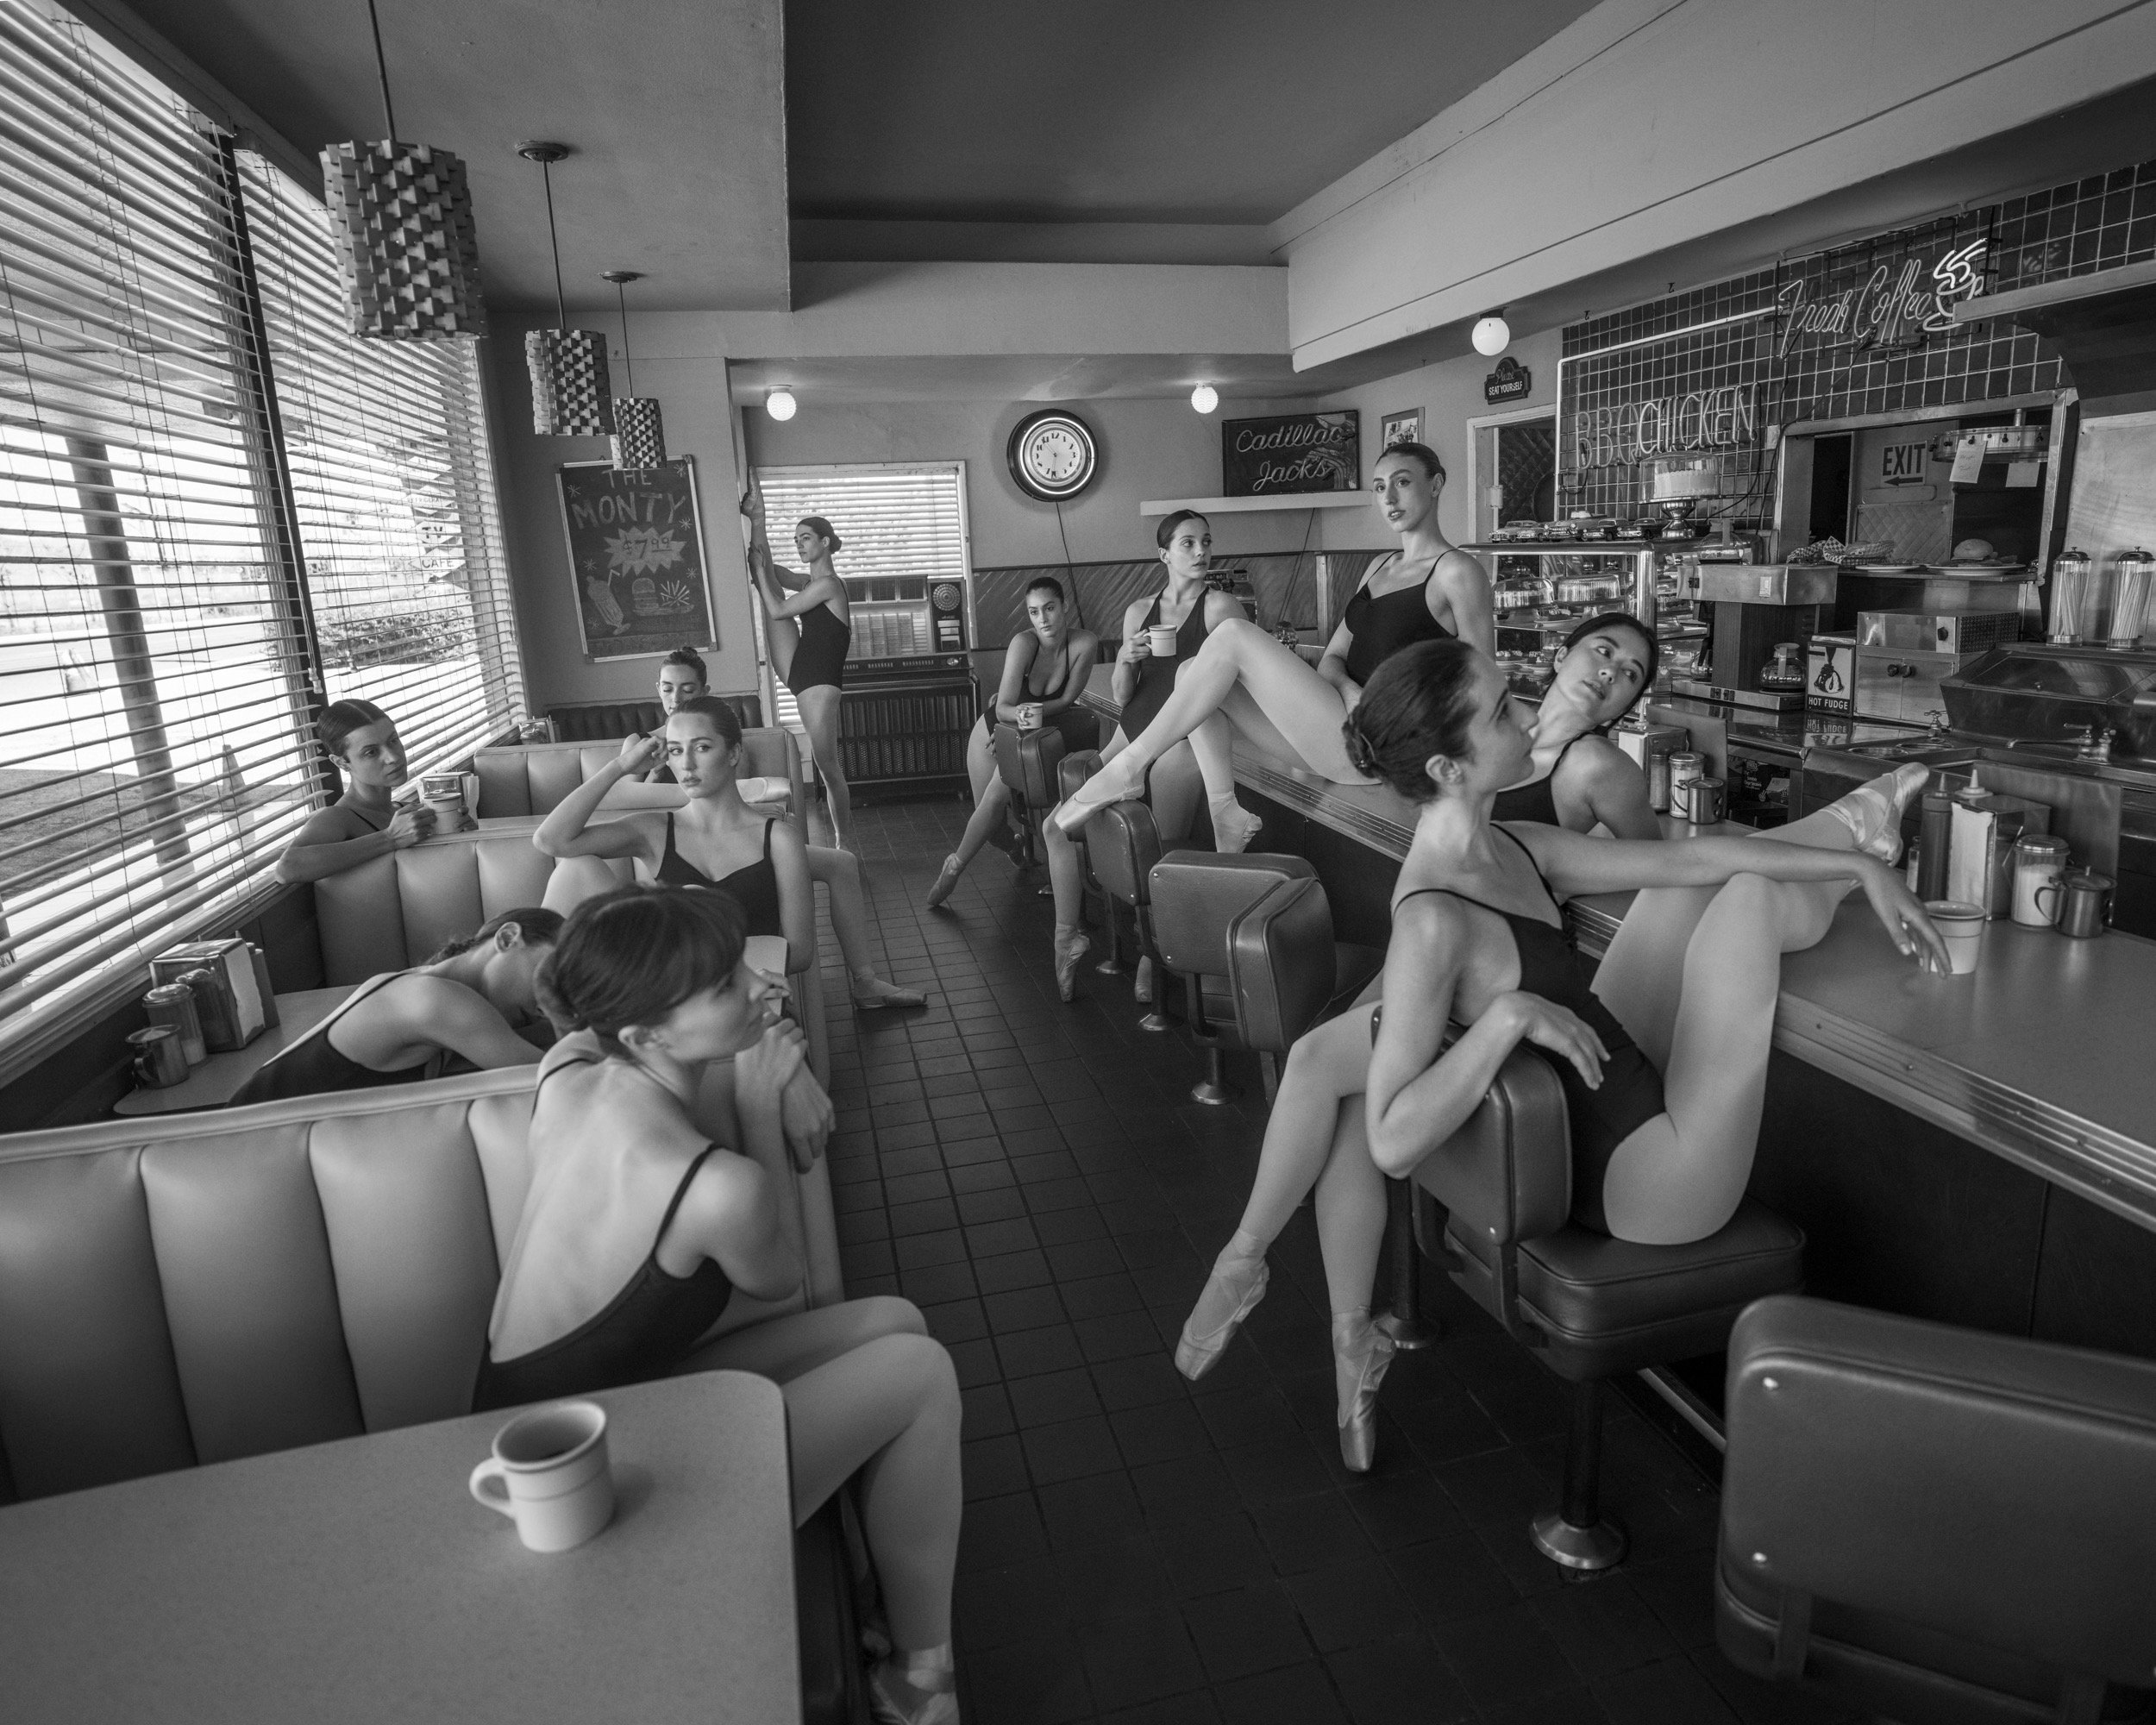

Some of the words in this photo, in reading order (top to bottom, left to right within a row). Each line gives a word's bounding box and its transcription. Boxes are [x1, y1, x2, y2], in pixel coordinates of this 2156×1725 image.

[1779, 279, 1853, 360] Fresh
[1854, 258, 1932, 346] Coffee
[1489, 386, 1500, 395] SEAT
[1500, 381, 1523, 393] YOURSELF
[1236, 423, 1344, 453] Cadillac
[1575, 402, 1639, 468] BBQ
[1639, 381, 1762, 455] CHICKEN
[1252, 457, 1332, 492] Jacks
[1883, 442, 1927, 477] EXIT
[601, 468, 652, 488] THE
[571, 492, 686, 530] MONTY
[422, 526, 442, 539] TV
[422, 559, 454, 568] CAFE
[1808, 697, 1822, 706] HOT
[1824, 699, 1848, 711] FUDGE
